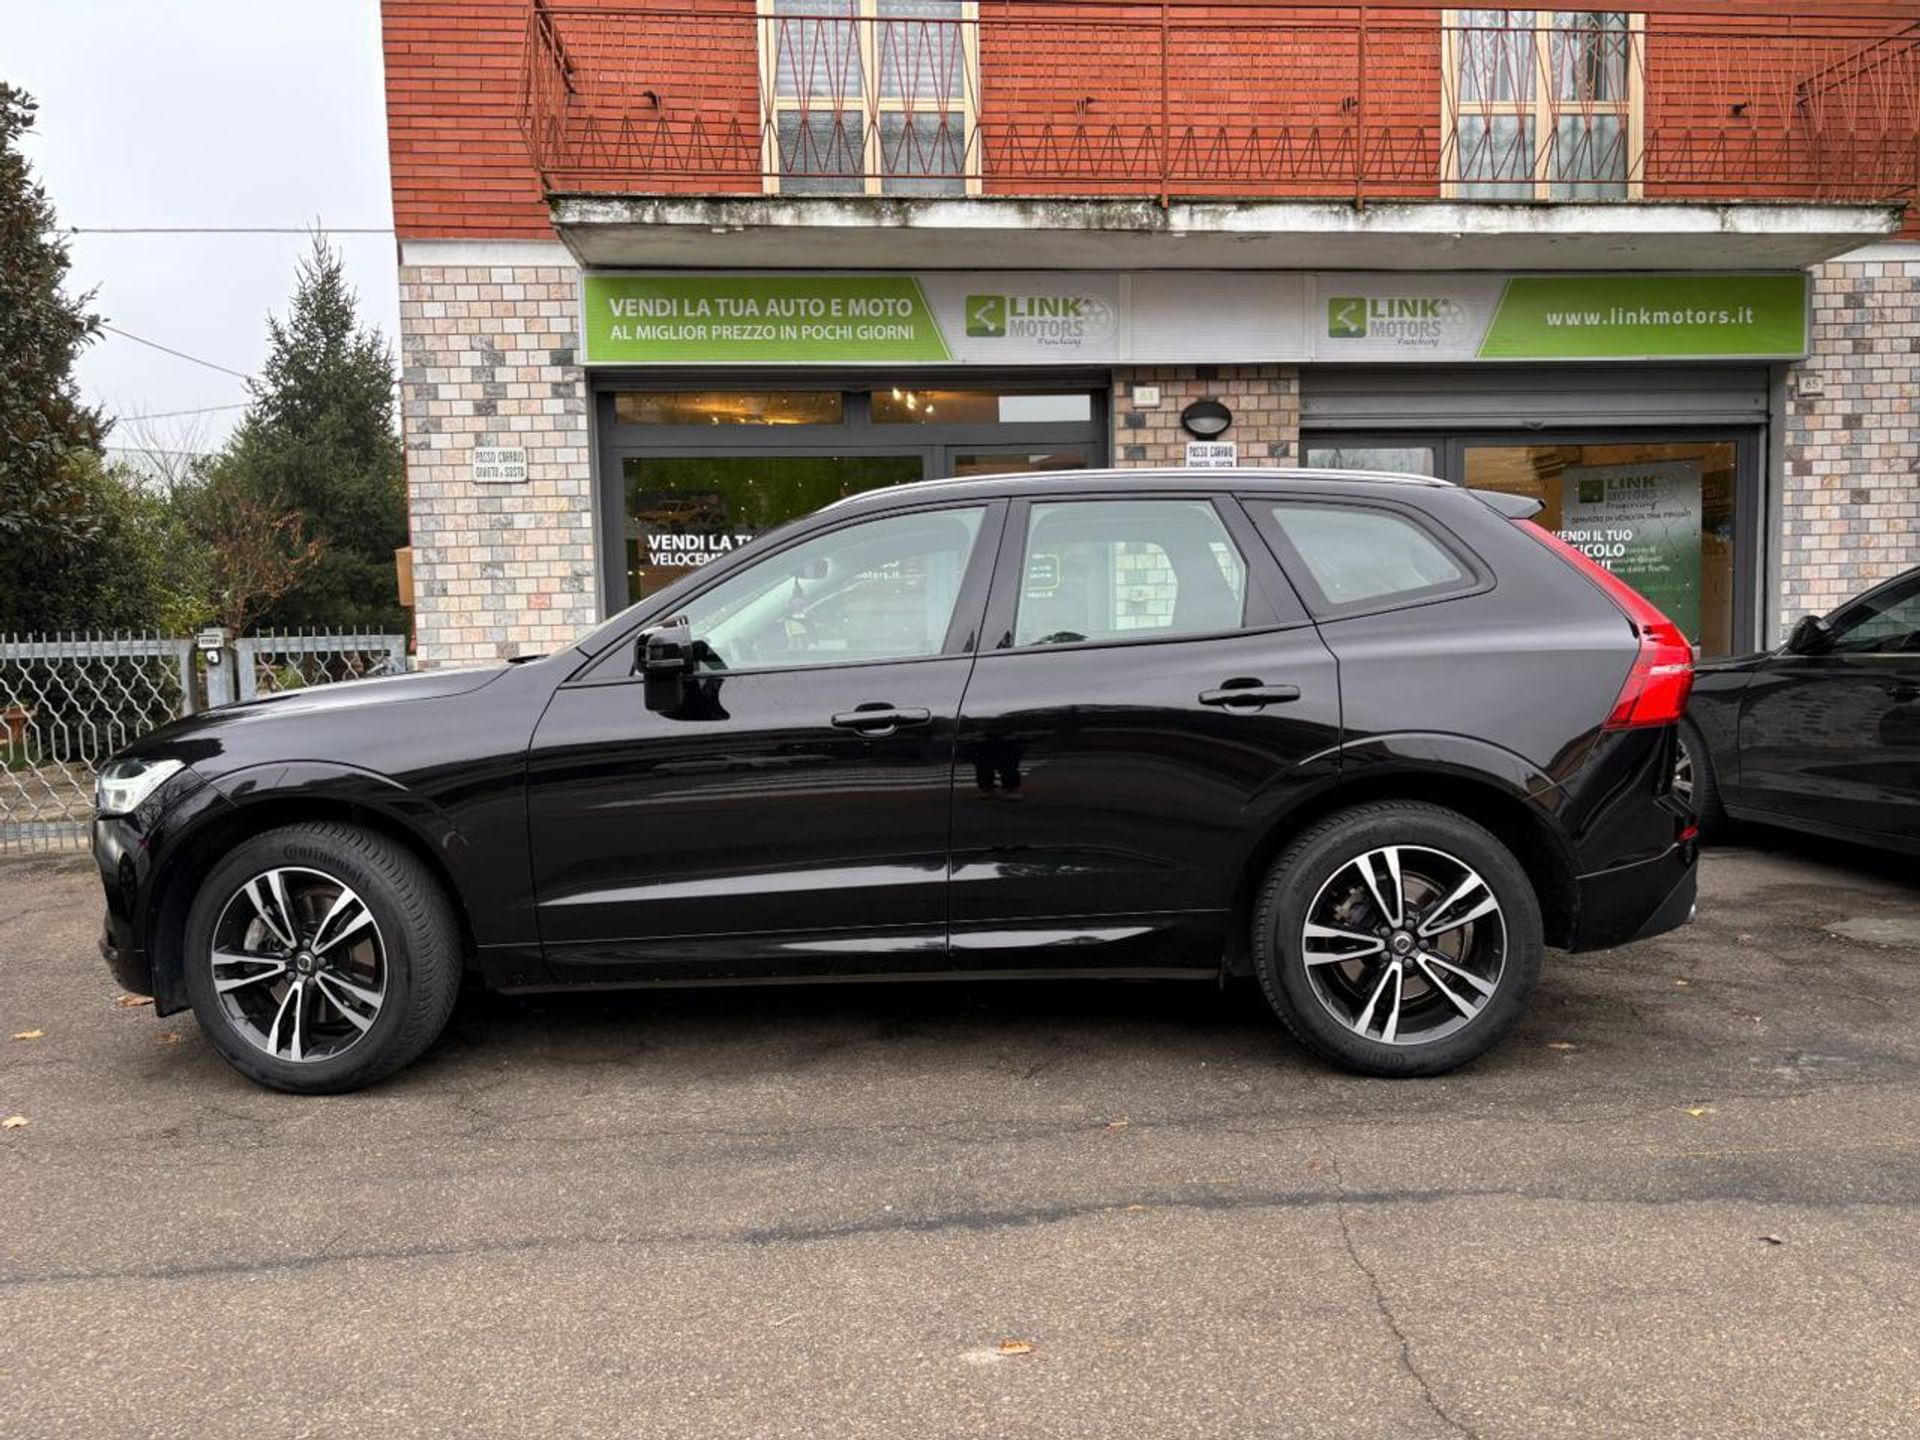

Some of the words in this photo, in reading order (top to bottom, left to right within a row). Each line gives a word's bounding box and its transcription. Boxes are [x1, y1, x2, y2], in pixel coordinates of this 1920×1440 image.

[609, 298, 678, 317] VENDI
[684, 298, 711, 317] LA
[715, 298, 760, 317] TUA
[765, 298, 825, 317] AUTO
[831, 298, 843, 317] E
[848, 298, 913, 317] MOTO
[1009, 297, 1082, 317] LINK
[1370, 298, 1441, 317] LINK
[1546, 306, 1754, 326] www.linkmotors.it
[611, 324, 633, 340] AL
[636, 324, 707, 340] MIGLIOR
[711, 324, 775, 340] PREZZO
[780, 324, 797, 340] IN
[802, 324, 852, 340] POCHI
[856, 324, 914, 340] GIORNI
[1009, 319, 1084, 337] MOTORS
[1370, 319, 1442, 337] MOTORS
[647, 534, 705, 551] VENDI
[709, 534, 732, 551] LA
[1593, 530, 1604, 542] IL
[1606, 529, 1633, 542] TUO
[649, 553, 723, 566] VELOCEM
